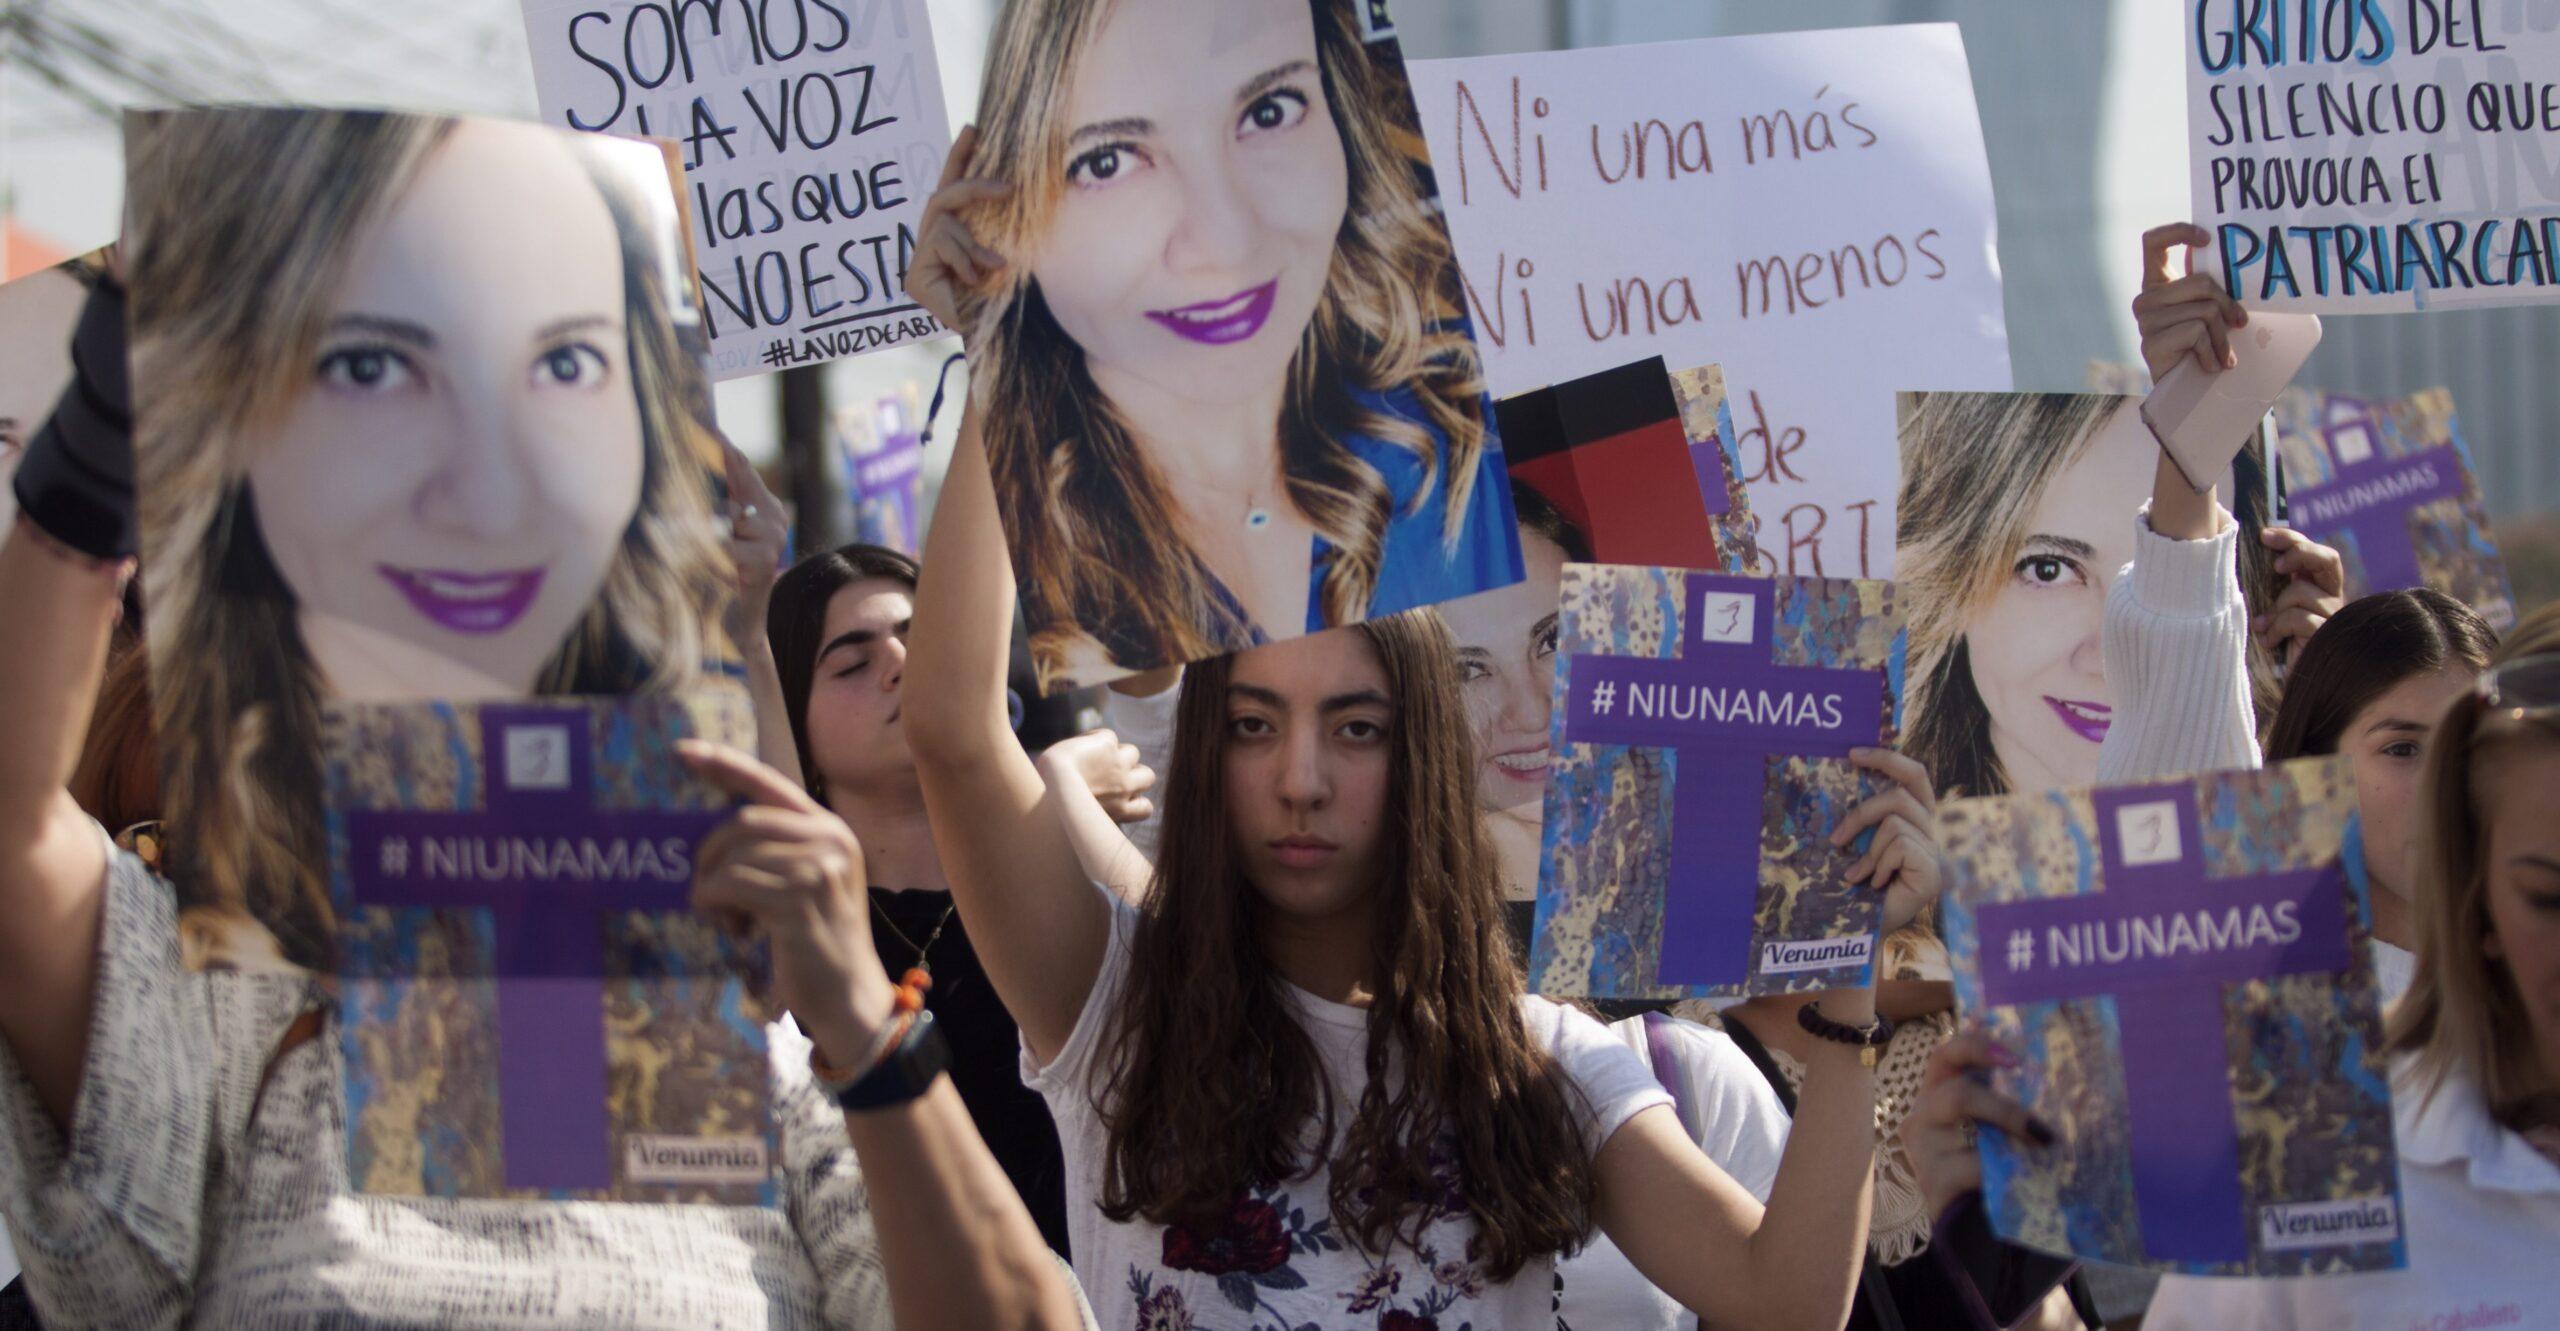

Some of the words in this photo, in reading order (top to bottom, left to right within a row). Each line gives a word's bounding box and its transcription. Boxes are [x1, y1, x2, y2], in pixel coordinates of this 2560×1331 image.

[2410, 0, 2506, 55] DEL
[743, 65, 899, 152] VOZ
[1456, 76, 1549, 205] Ni
[1593, 118, 1713, 184] una
[1741, 84, 1877, 165] más
[2208, 83, 2446, 146] SILENCIO
[2467, 82, 2560, 133] QUE
[792, 161, 908, 225] QUE
[2211, 156, 2391, 214] PROVOCA
[1578, 276, 1702, 342] una
[1737, 228, 1946, 319] menos
[1740, 390, 1806, 483] de
[1628, 682, 1843, 729] NIUNAMAS
[421, 835, 691, 883] NIUNAMAS
[1765, 938, 1868, 965] Venumia
[2046, 900, 2303, 967] NIUNAMAS
[2263, 1201, 2394, 1236] Venumia
